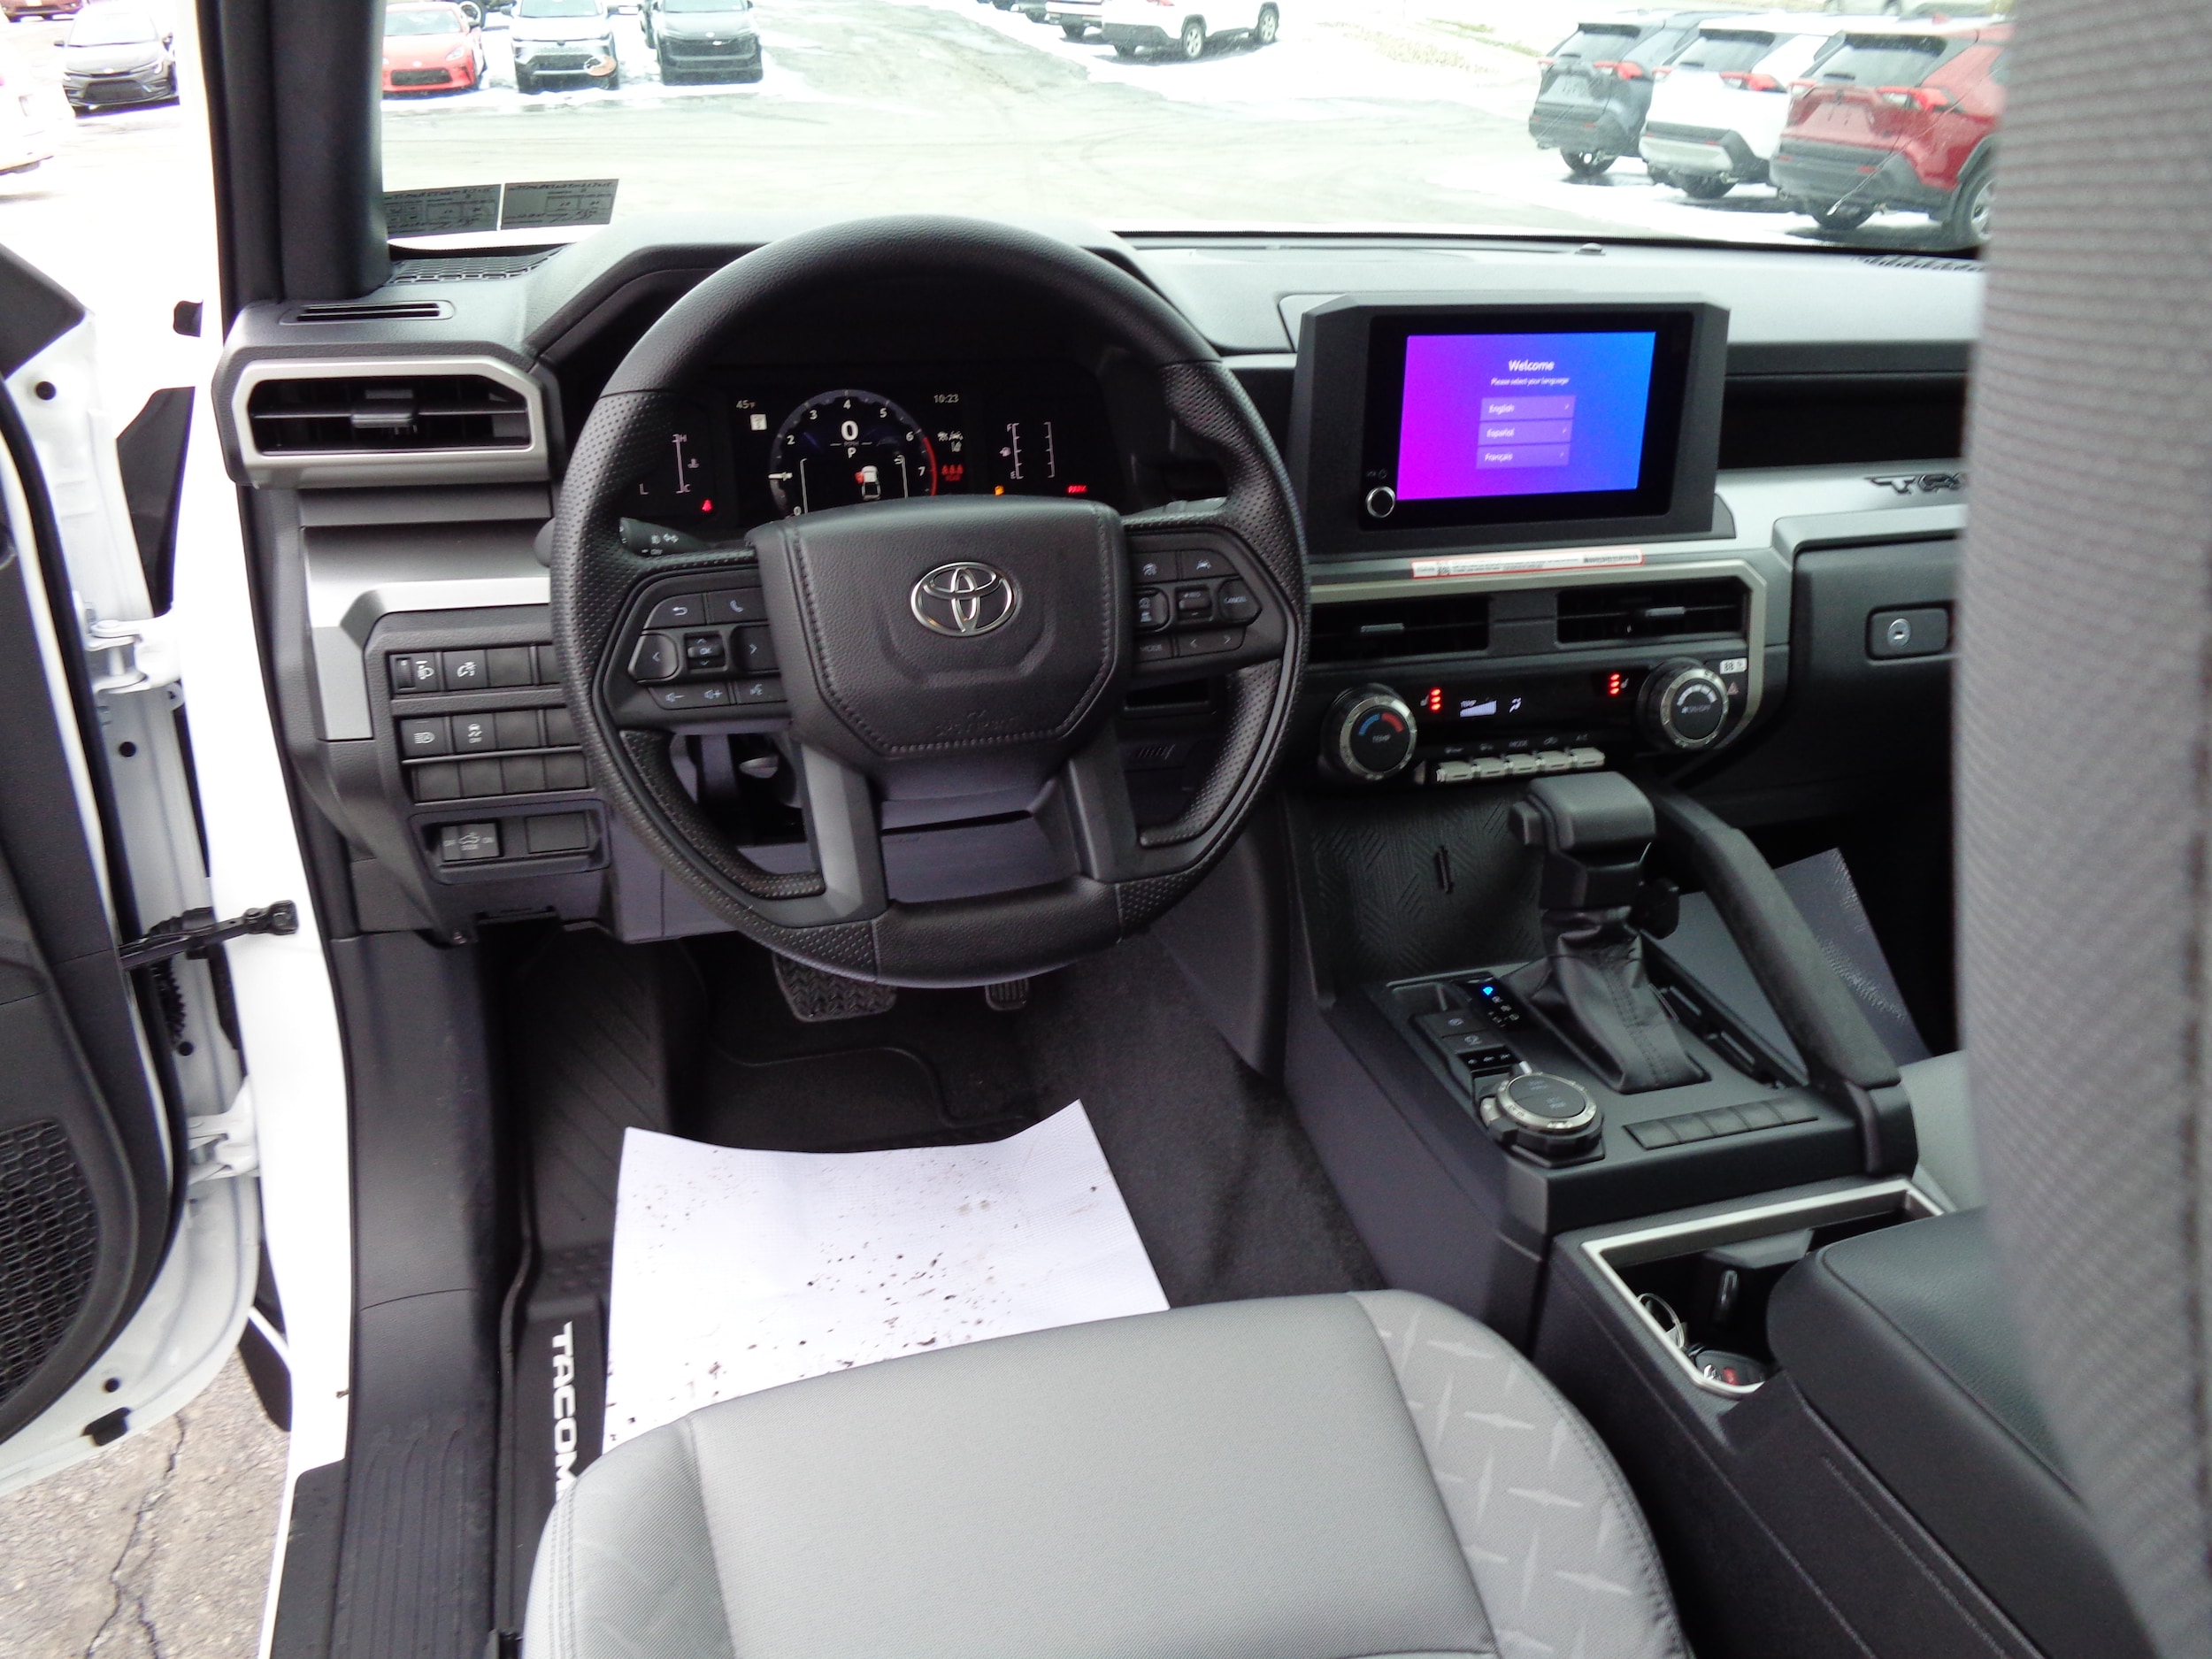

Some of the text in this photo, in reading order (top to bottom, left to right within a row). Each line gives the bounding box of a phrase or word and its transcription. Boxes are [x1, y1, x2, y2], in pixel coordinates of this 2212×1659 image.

[1508, 358, 1555, 372] Welcome
[1490, 377, 1509, 386] Please
[1527, 378, 1541, 387] your
[1541, 376, 1570, 387] language
[933, 394, 959, 403] 10:23
[843, 399, 851, 410] 4
[1488, 403, 1515, 415] English
[809, 410, 818, 420] 3
[879, 408, 887, 419] 5
[841, 420, 858, 441] 0
[1486, 428, 1515, 439] Español
[787, 434, 795, 445] 2
[906, 431, 914, 442] 6
[848, 447, 856, 458] P
[1484, 452, 1514, 463] Français
[918, 466, 926, 476] 7
[639, 483, 649, 495] L
[551, 1320, 578, 1502] TACOM
